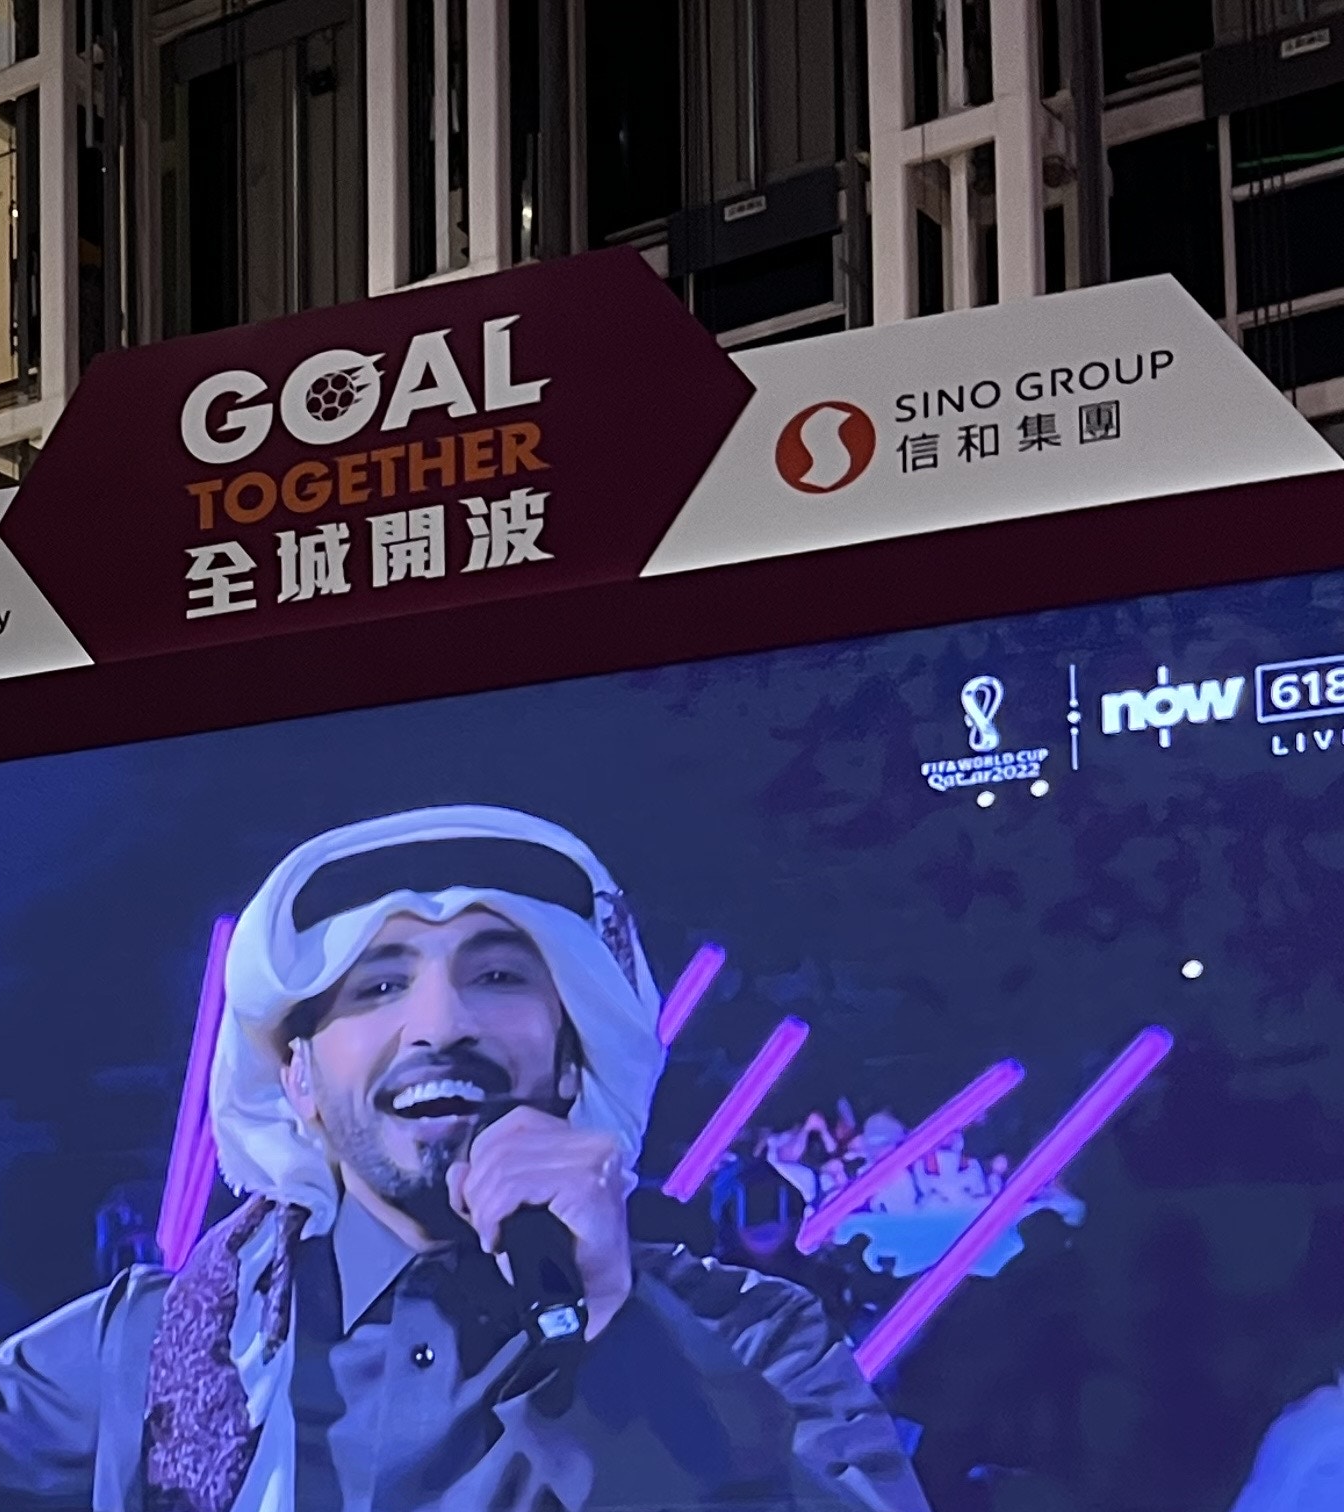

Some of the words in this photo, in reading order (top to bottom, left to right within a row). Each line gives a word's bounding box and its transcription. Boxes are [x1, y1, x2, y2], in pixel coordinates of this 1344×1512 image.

[180, 314, 552, 465] GOAL
[894, 379, 1002, 422] SINO
[1015, 349, 1175, 401] GROUP
[895, 400, 1121, 474] 信和集團
[184, 420, 552, 531] TOGETHER
[184, 487, 555, 620] 全城開波
[1101, 667, 1246, 746] now
[1271, 727, 1344, 757] LIV
[921, 758, 959, 777] FIFA
[958, 750, 1015, 772] WORLD
[1017, 748, 1049, 764] CUP
